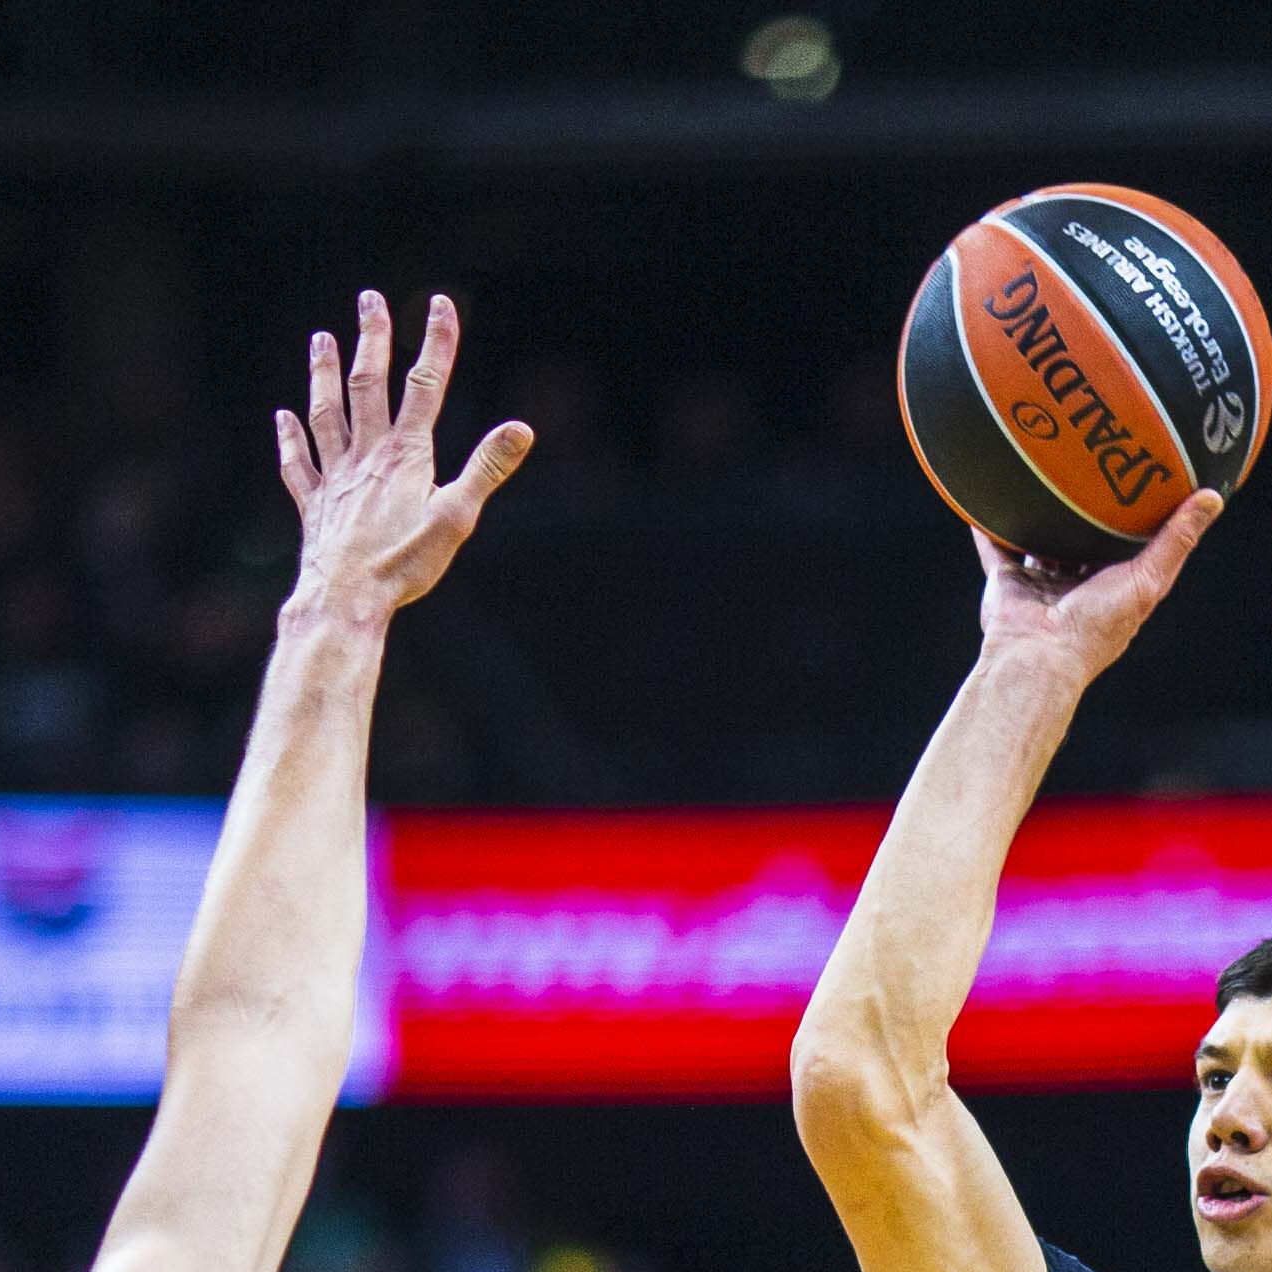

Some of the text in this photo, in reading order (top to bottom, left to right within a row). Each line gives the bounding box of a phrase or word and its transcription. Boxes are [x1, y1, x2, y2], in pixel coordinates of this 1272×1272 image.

[984, 261, 1173, 506] SPALDING
[1063, 221, 1211, 396] TURKISH AIRLINES
[1124, 236, 1231, 384] EuroLeague
